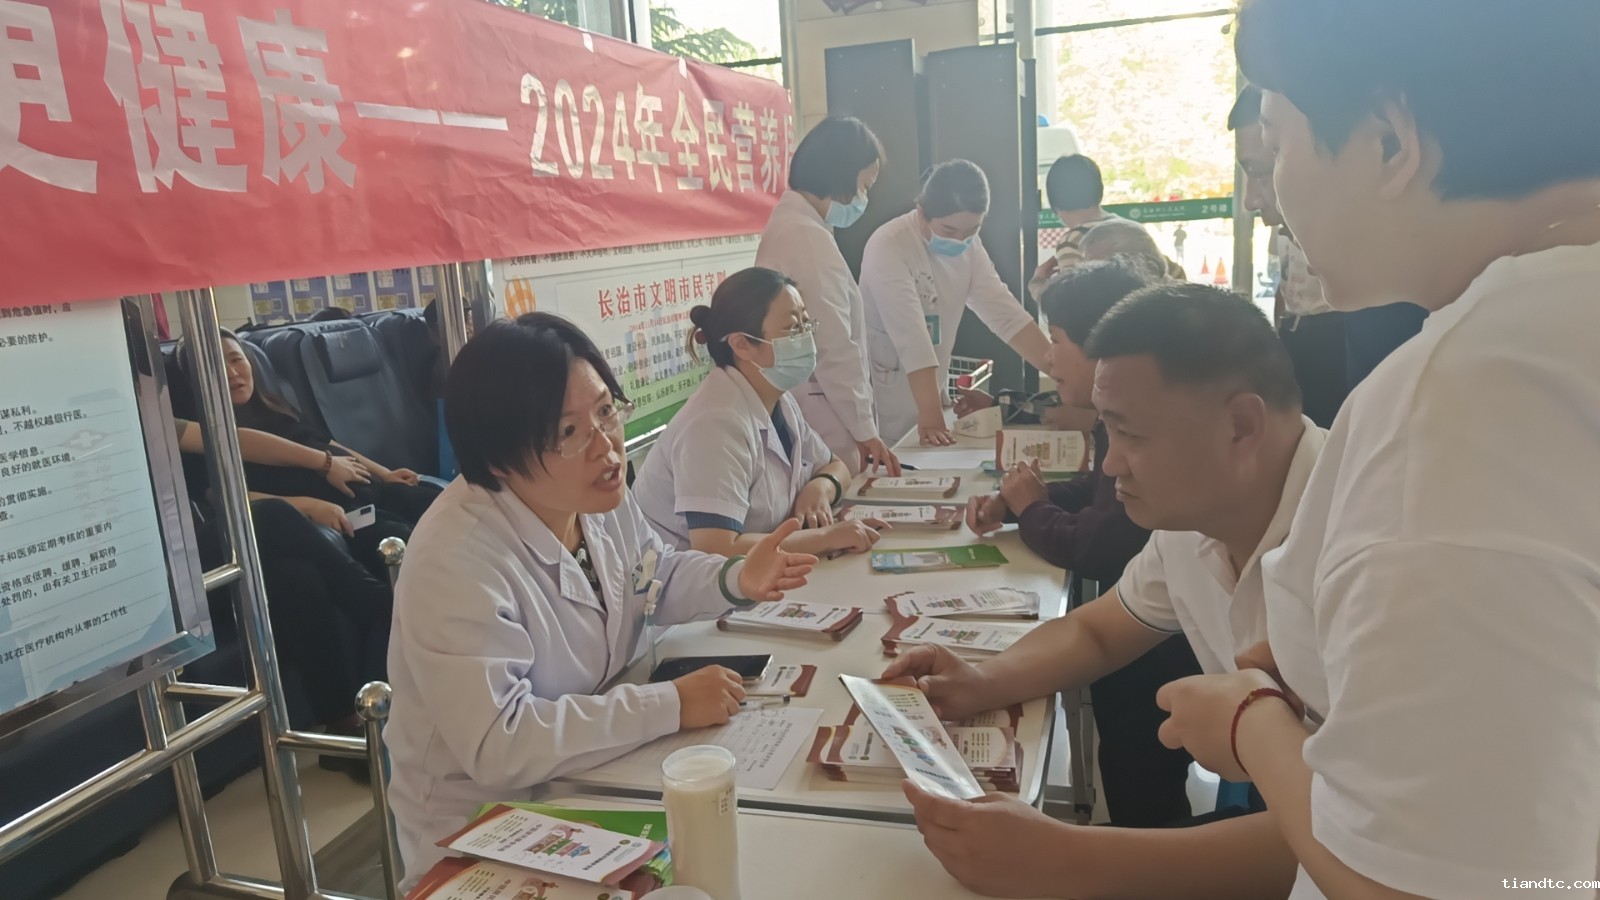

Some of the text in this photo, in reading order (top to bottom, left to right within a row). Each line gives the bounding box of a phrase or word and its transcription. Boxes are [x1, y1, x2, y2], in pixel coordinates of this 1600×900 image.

[0, 409, 88, 436] ，不越权越级行医。
[1, 452, 76, 478] 良好的就医环境。
